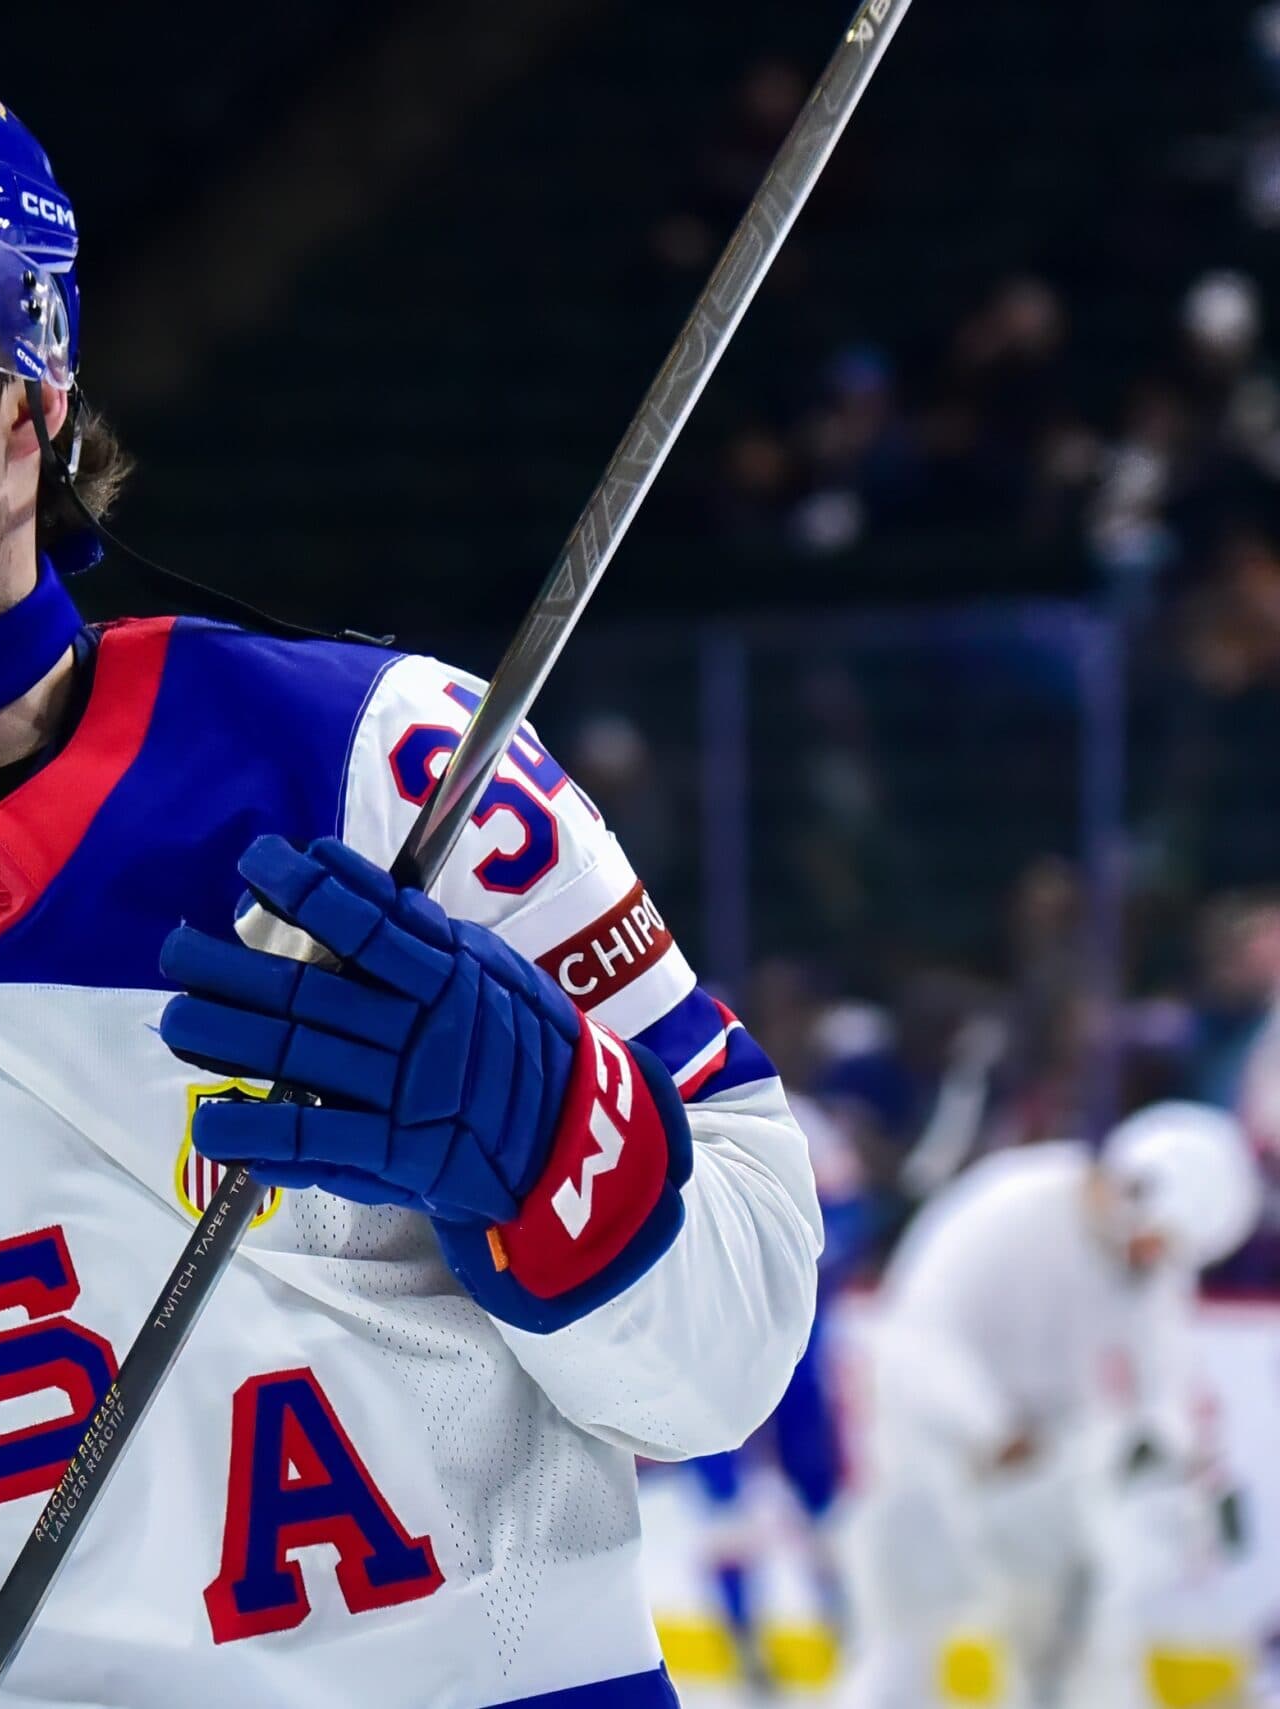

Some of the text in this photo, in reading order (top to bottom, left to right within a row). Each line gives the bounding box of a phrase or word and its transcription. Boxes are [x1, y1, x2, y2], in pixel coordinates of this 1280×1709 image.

[22, 191, 76, 231] CCM
[17, 347, 42, 378] CCM
[153, 1262, 197, 1329] TWITCH
[193, 1201, 232, 1256] TAPER
[35, 1383, 121, 1542] REACTIVE RELEASE
[49, 1474, 89, 1543] LANCER
